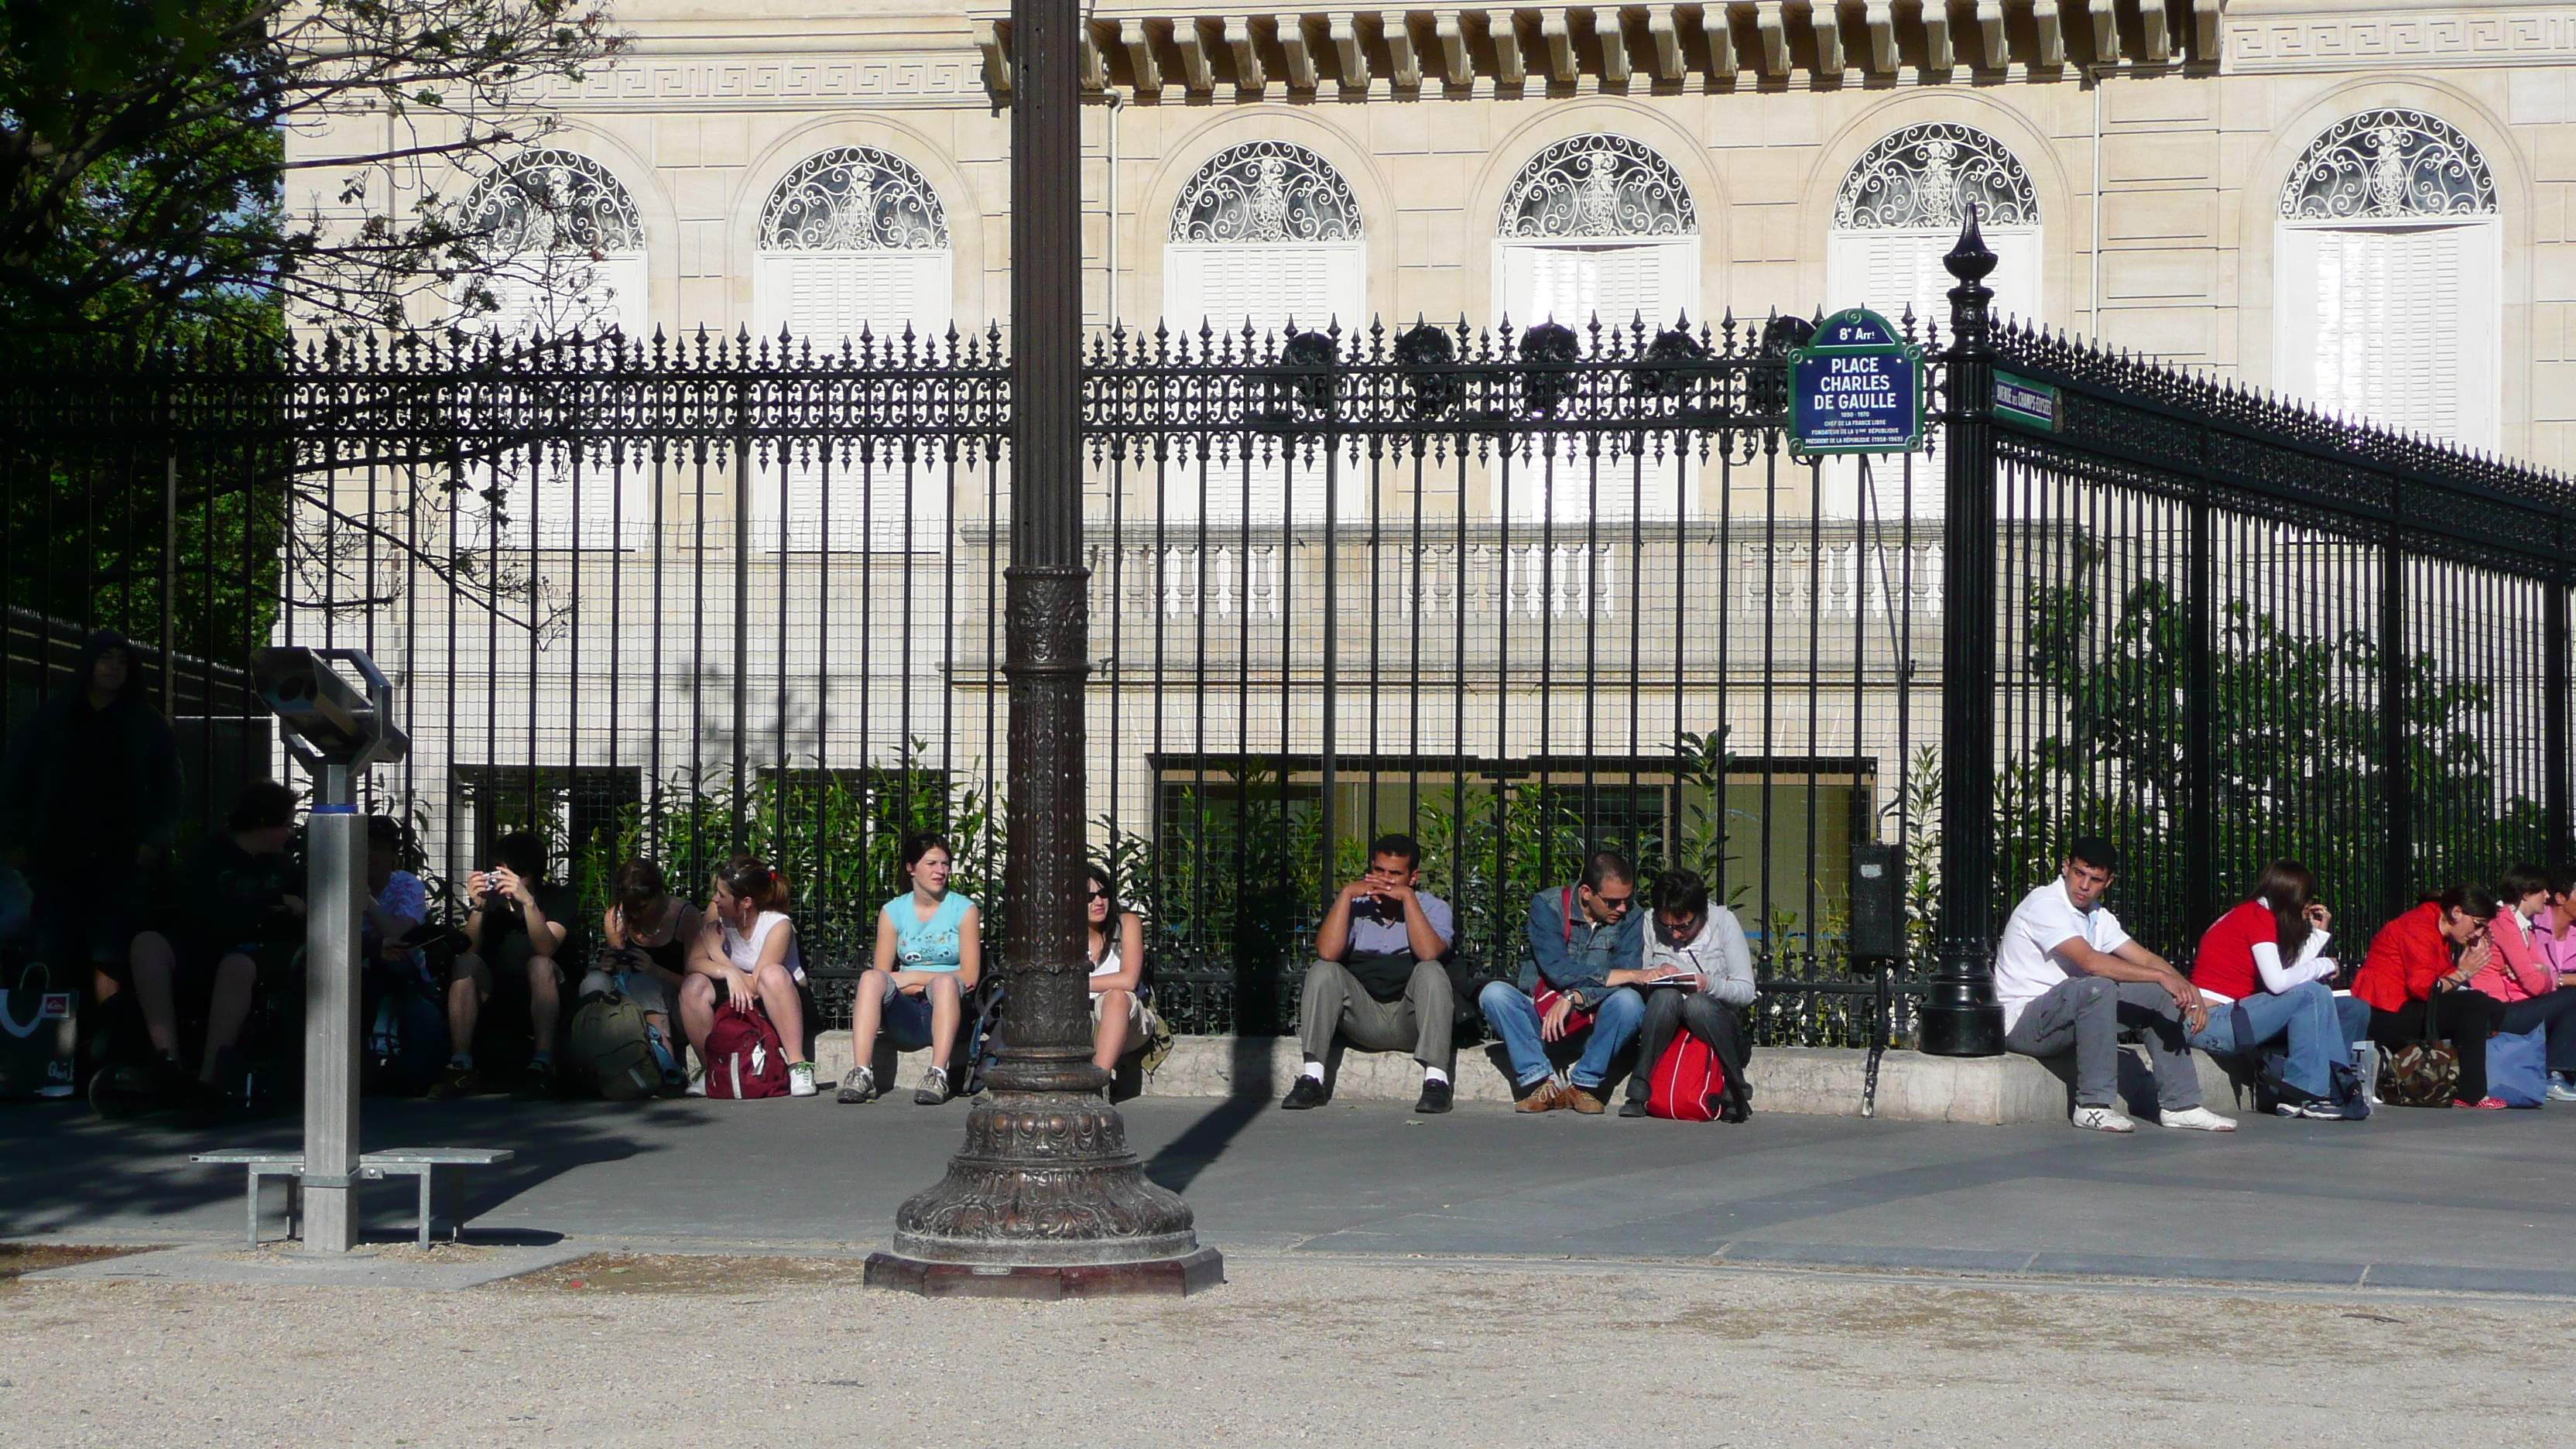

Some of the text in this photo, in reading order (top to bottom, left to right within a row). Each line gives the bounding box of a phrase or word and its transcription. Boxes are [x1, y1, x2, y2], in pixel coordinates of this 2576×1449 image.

[1831, 358, 1879, 373] PLACE
[1821, 375, 1890, 392] CHARLES
[1814, 393, 1896, 409] DE GAULLE
[1997, 385, 2011, 404] AVENUE
